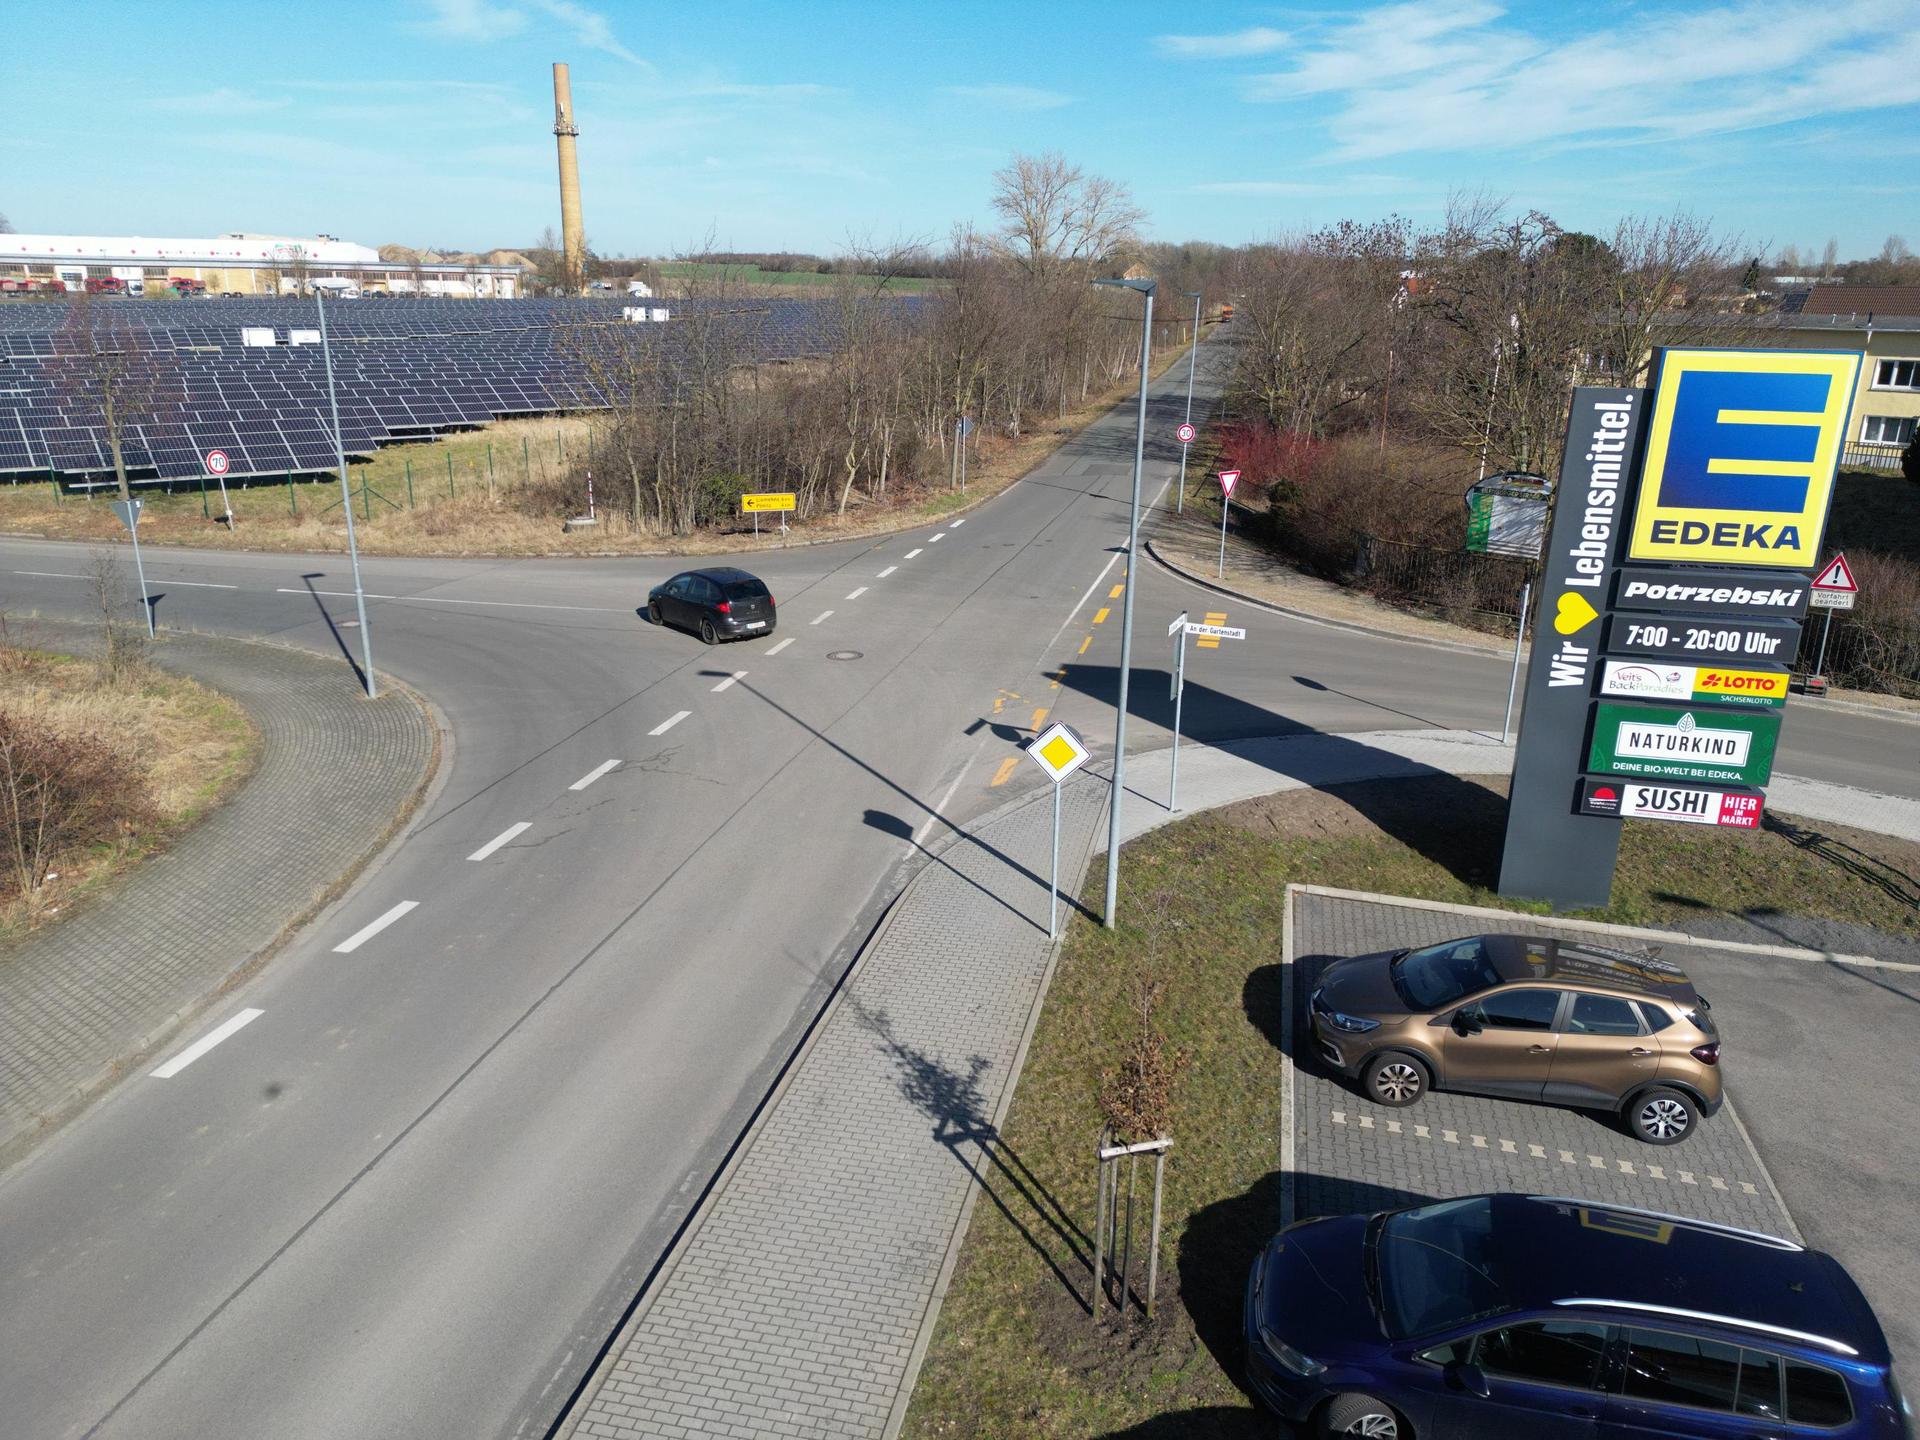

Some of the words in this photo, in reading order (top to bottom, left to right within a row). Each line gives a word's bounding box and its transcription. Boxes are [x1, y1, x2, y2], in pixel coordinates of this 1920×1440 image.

[212, 457, 225, 468] 70
[1564, 394, 1634, 588] Lebensmittel.
[1650, 520, 1801, 550] EDEKA
[1624, 581, 1803, 607] Potrzebski
[1817, 592, 1849, 600] Vorfahrt
[1209, 627, 1241, 638] Gartenstadt
[1626, 625, 1669, 647] 7:00
[1684, 628, 1741, 651] 20:00
[1744, 631, 1781, 655] Uhr
[1548, 641, 1590, 687] Wir
[1723, 676, 1776, 691] LOTTO
[1719, 695, 1773, 705] SACHSENLOTTO
[1629, 732, 1737, 756] NATURKIND
[1612, 762, 1643, 772] DEINE
[1643, 765, 1690, 776] BIO-WELT
[1690, 769, 1706, 777] BEI
[1708, 771, 1744, 780] EDEKA.
[1635, 787, 1710, 814] SUSHI
[1724, 797, 1758, 811] HIER
[1721, 815, 1754, 827] MARKT
[1733, 809, 1744, 817] IM
